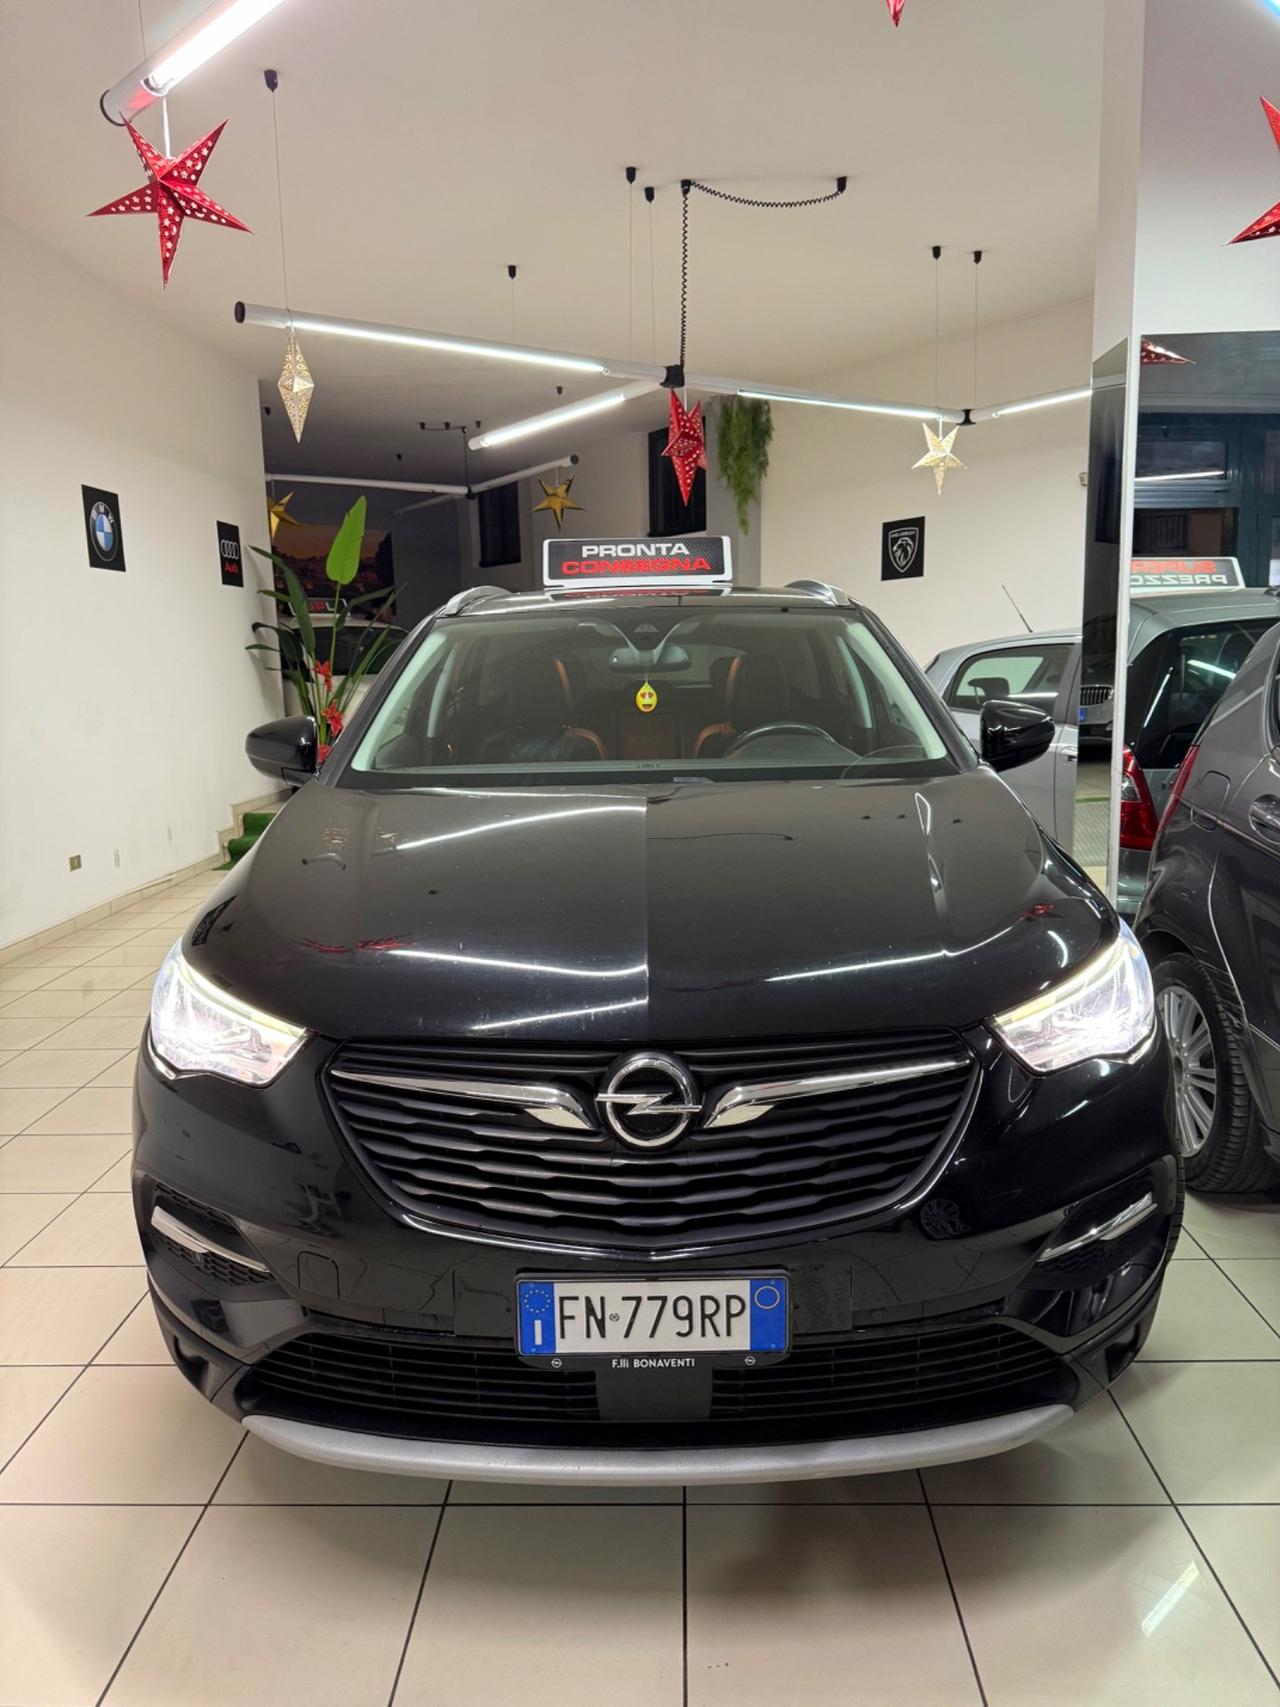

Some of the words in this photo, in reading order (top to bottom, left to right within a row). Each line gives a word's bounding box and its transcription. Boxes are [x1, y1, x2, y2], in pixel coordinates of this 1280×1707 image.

[582, 543, 690, 558] PRONTA
[562, 557, 712, 574] CONSEGNA
[534, 1320, 543, 1345] I
[633, 1358, 695, 1368] BONAVENTI
